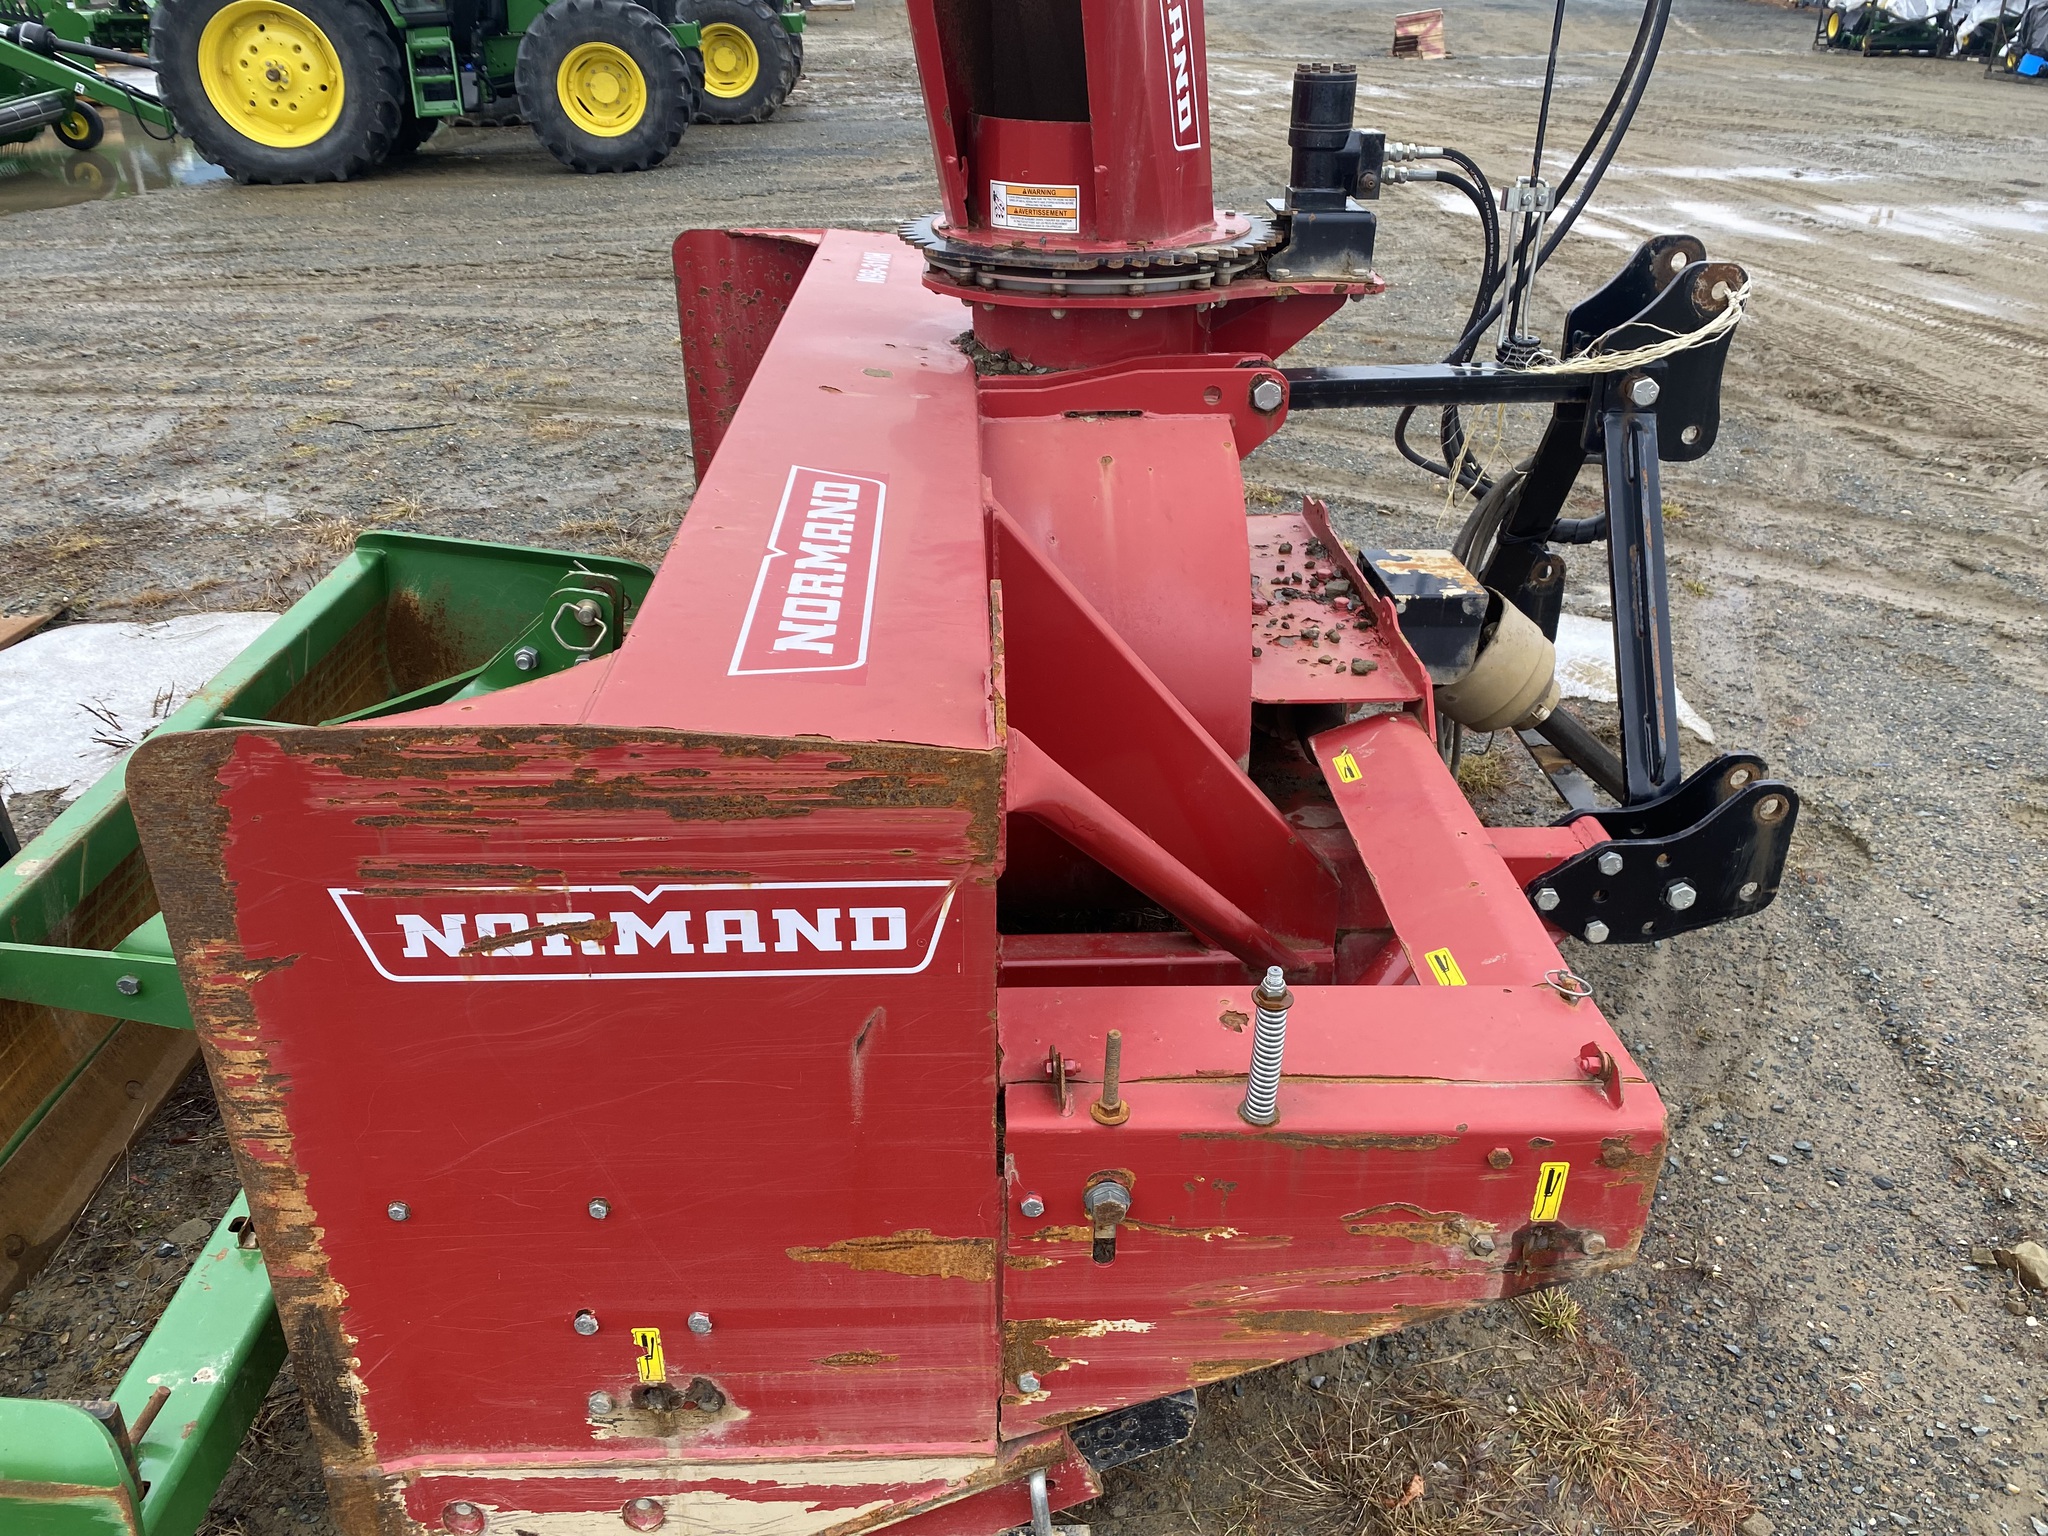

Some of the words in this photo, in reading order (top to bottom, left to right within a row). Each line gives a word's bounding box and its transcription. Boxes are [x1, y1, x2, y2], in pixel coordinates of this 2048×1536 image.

[1167, 0, 1192, 133] AND
[1019, 209, 1067, 217] AVERTISSEMENT
[1026, 188, 1056, 196] WARNING
[773, 481, 860, 655] NORMAND
[395, 907, 907, 957] NORMAND
